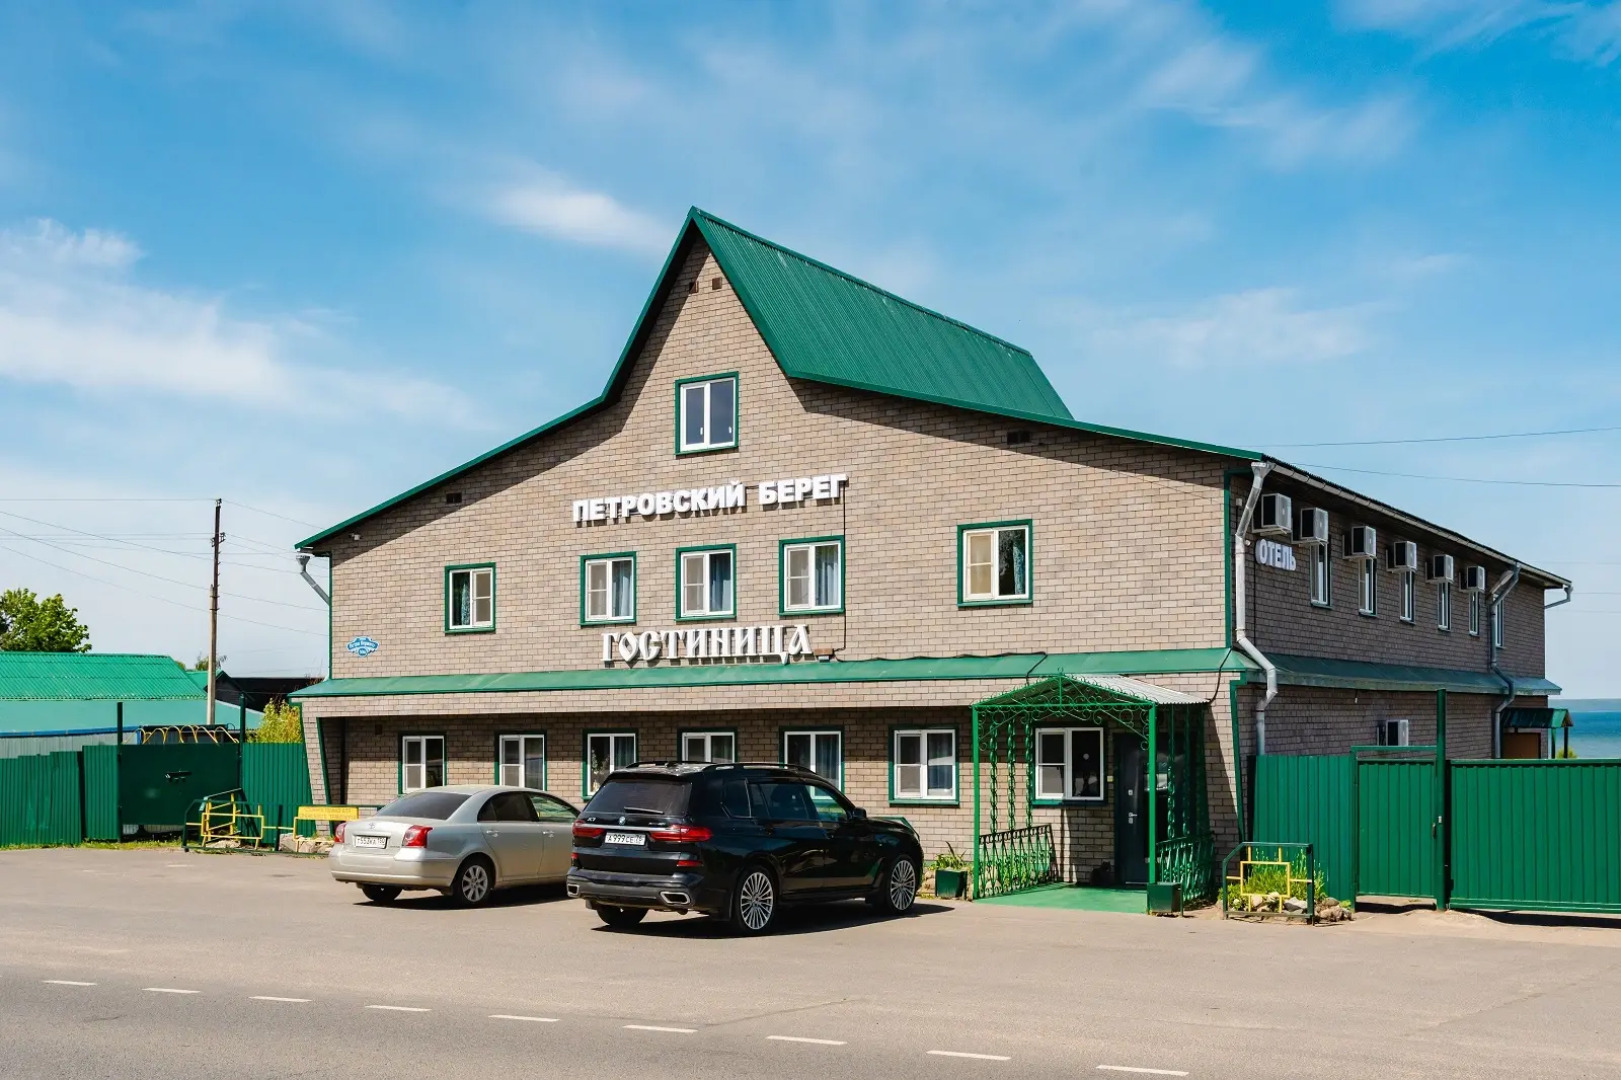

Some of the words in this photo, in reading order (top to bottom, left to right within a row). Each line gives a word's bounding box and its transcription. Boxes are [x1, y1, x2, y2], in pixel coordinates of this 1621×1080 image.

[573, 480, 746, 522] ПЕТРОВСКИЙ
[758, 474, 848, 505] БЕРЕГ
[1255, 539, 1296, 571] ОТЕЛЬ
[601, 624, 813, 665] ГОСТИНИЦА
